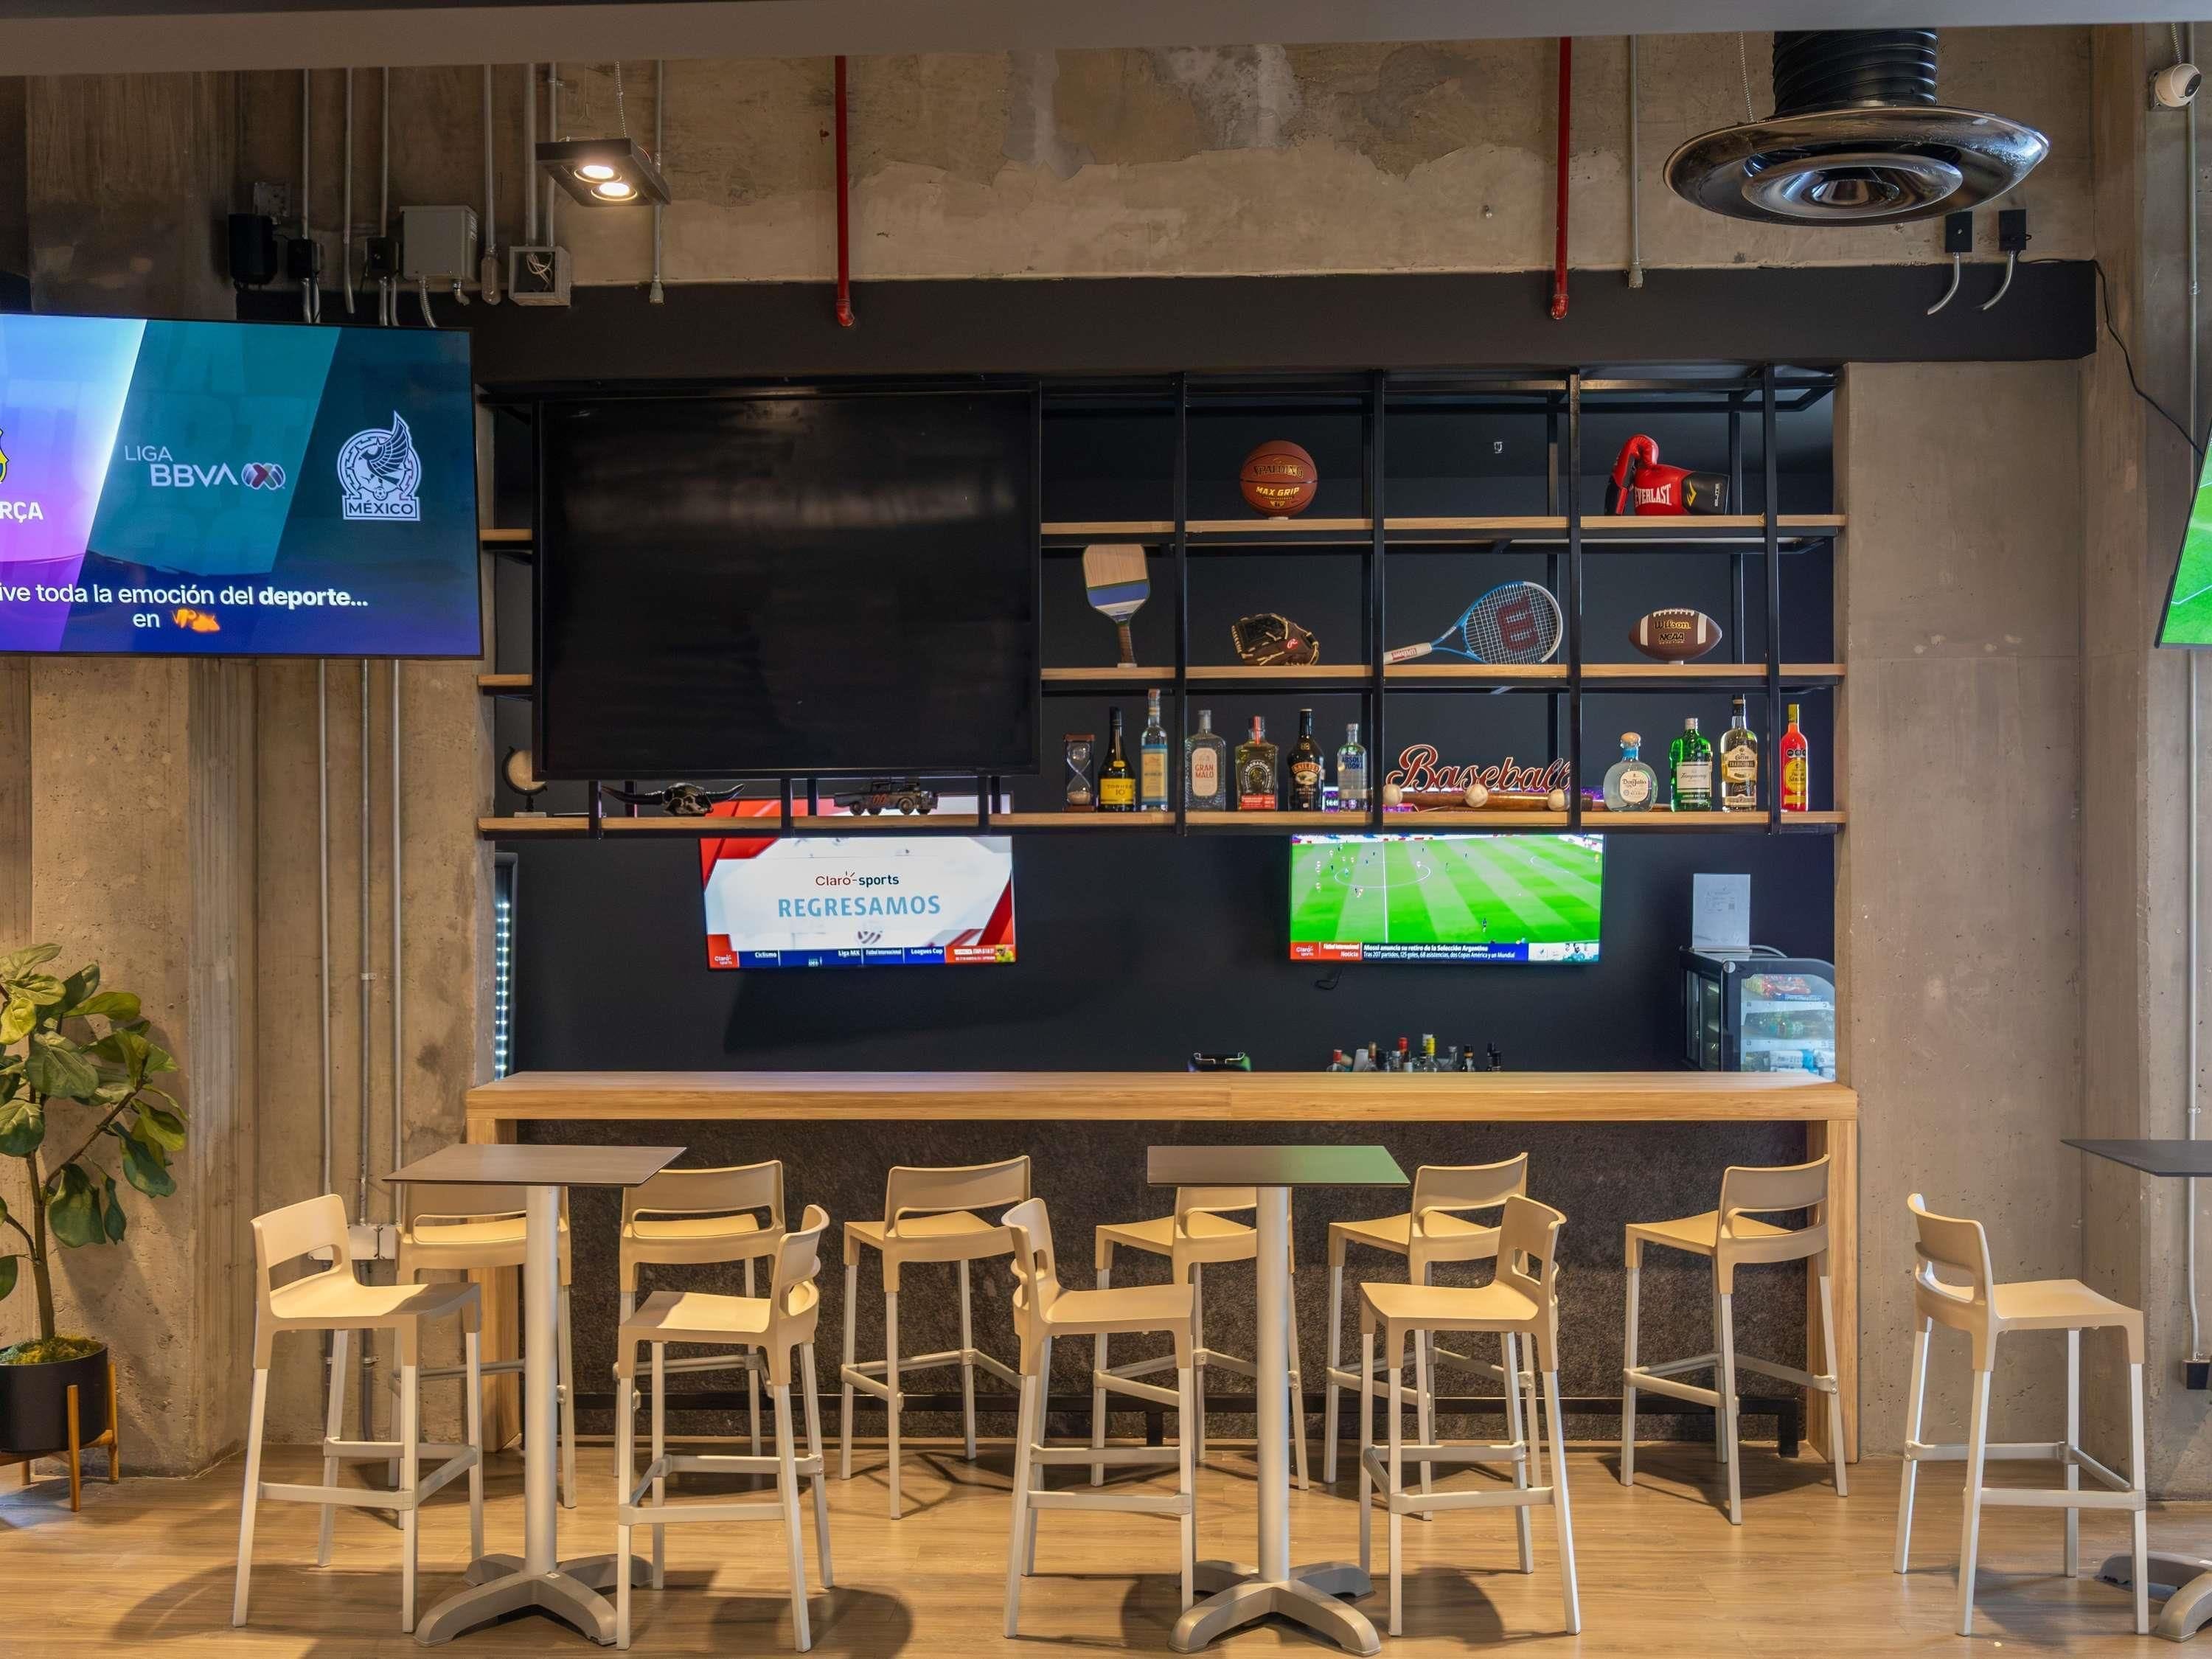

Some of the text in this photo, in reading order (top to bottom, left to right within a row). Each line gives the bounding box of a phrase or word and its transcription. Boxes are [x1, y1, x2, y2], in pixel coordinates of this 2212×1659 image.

[124, 445, 173, 462] LIGA
[149, 463, 238, 487] BBVA
[1256, 487, 1300, 496] MAX GRIP
[1635, 484, 1672, 507] EVERLAST
[347, 500, 414, 515] MÉXICO
[35, 584, 88, 602] toda
[94, 584, 113, 603] la
[118, 585, 215, 604] emoción
[220, 586, 254, 605] del
[258, 587, 369, 610] deporte...
[133, 613, 161, 627] en
[815, 873, 899, 888] Claro sports
[779, 894, 941, 917] REGRESAMOS
